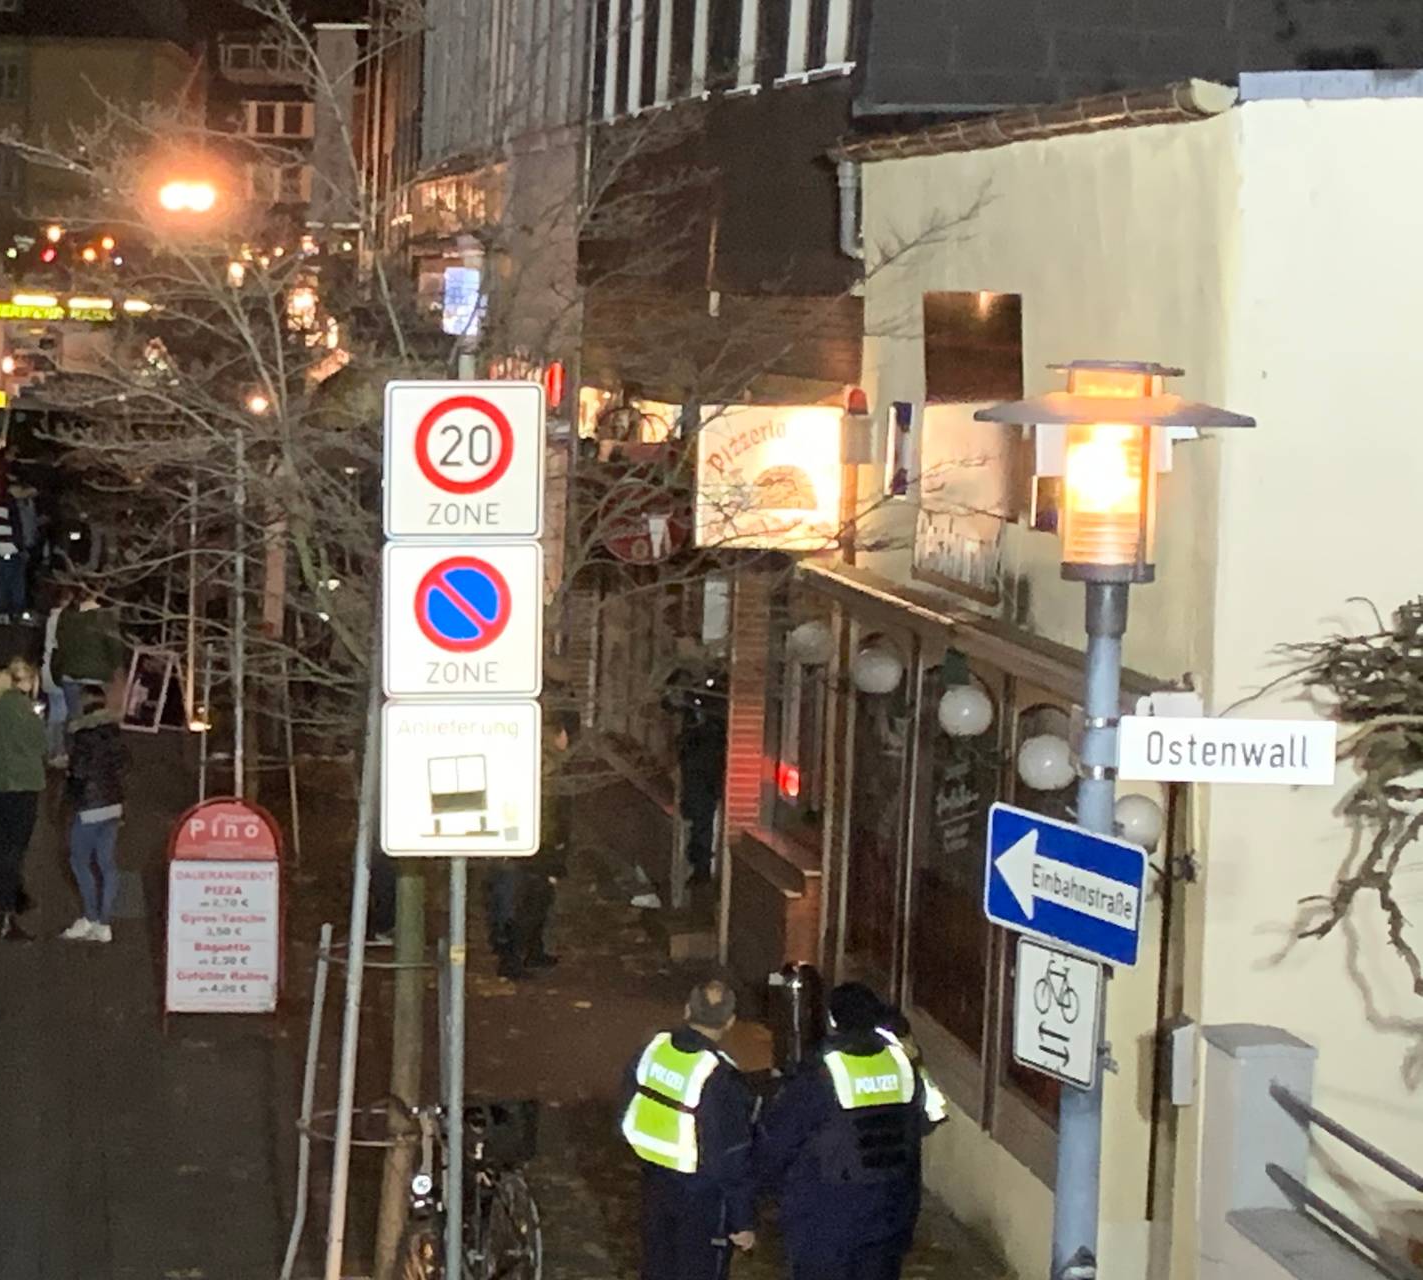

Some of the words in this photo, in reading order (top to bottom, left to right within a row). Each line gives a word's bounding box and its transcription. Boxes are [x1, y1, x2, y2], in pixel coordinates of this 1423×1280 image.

[439, 424, 493, 467] 20
[427, 502, 500, 526] ZONE
[426, 661, 499, 684] ZONE
[396, 719, 520, 741] Anlieferung
[1146, 730, 1309, 769] Ostenwall
[189, 817, 259, 841] Pino
[175, 870, 273, 881] DAUERANGEBOT
[204, 886, 243, 895] PIZZA
[1032, 862, 1133, 920] Einbahnstraße
[649, 1062, 685, 1091] POLIZEI
[855, 1074, 898, 1094] POLIZEI
